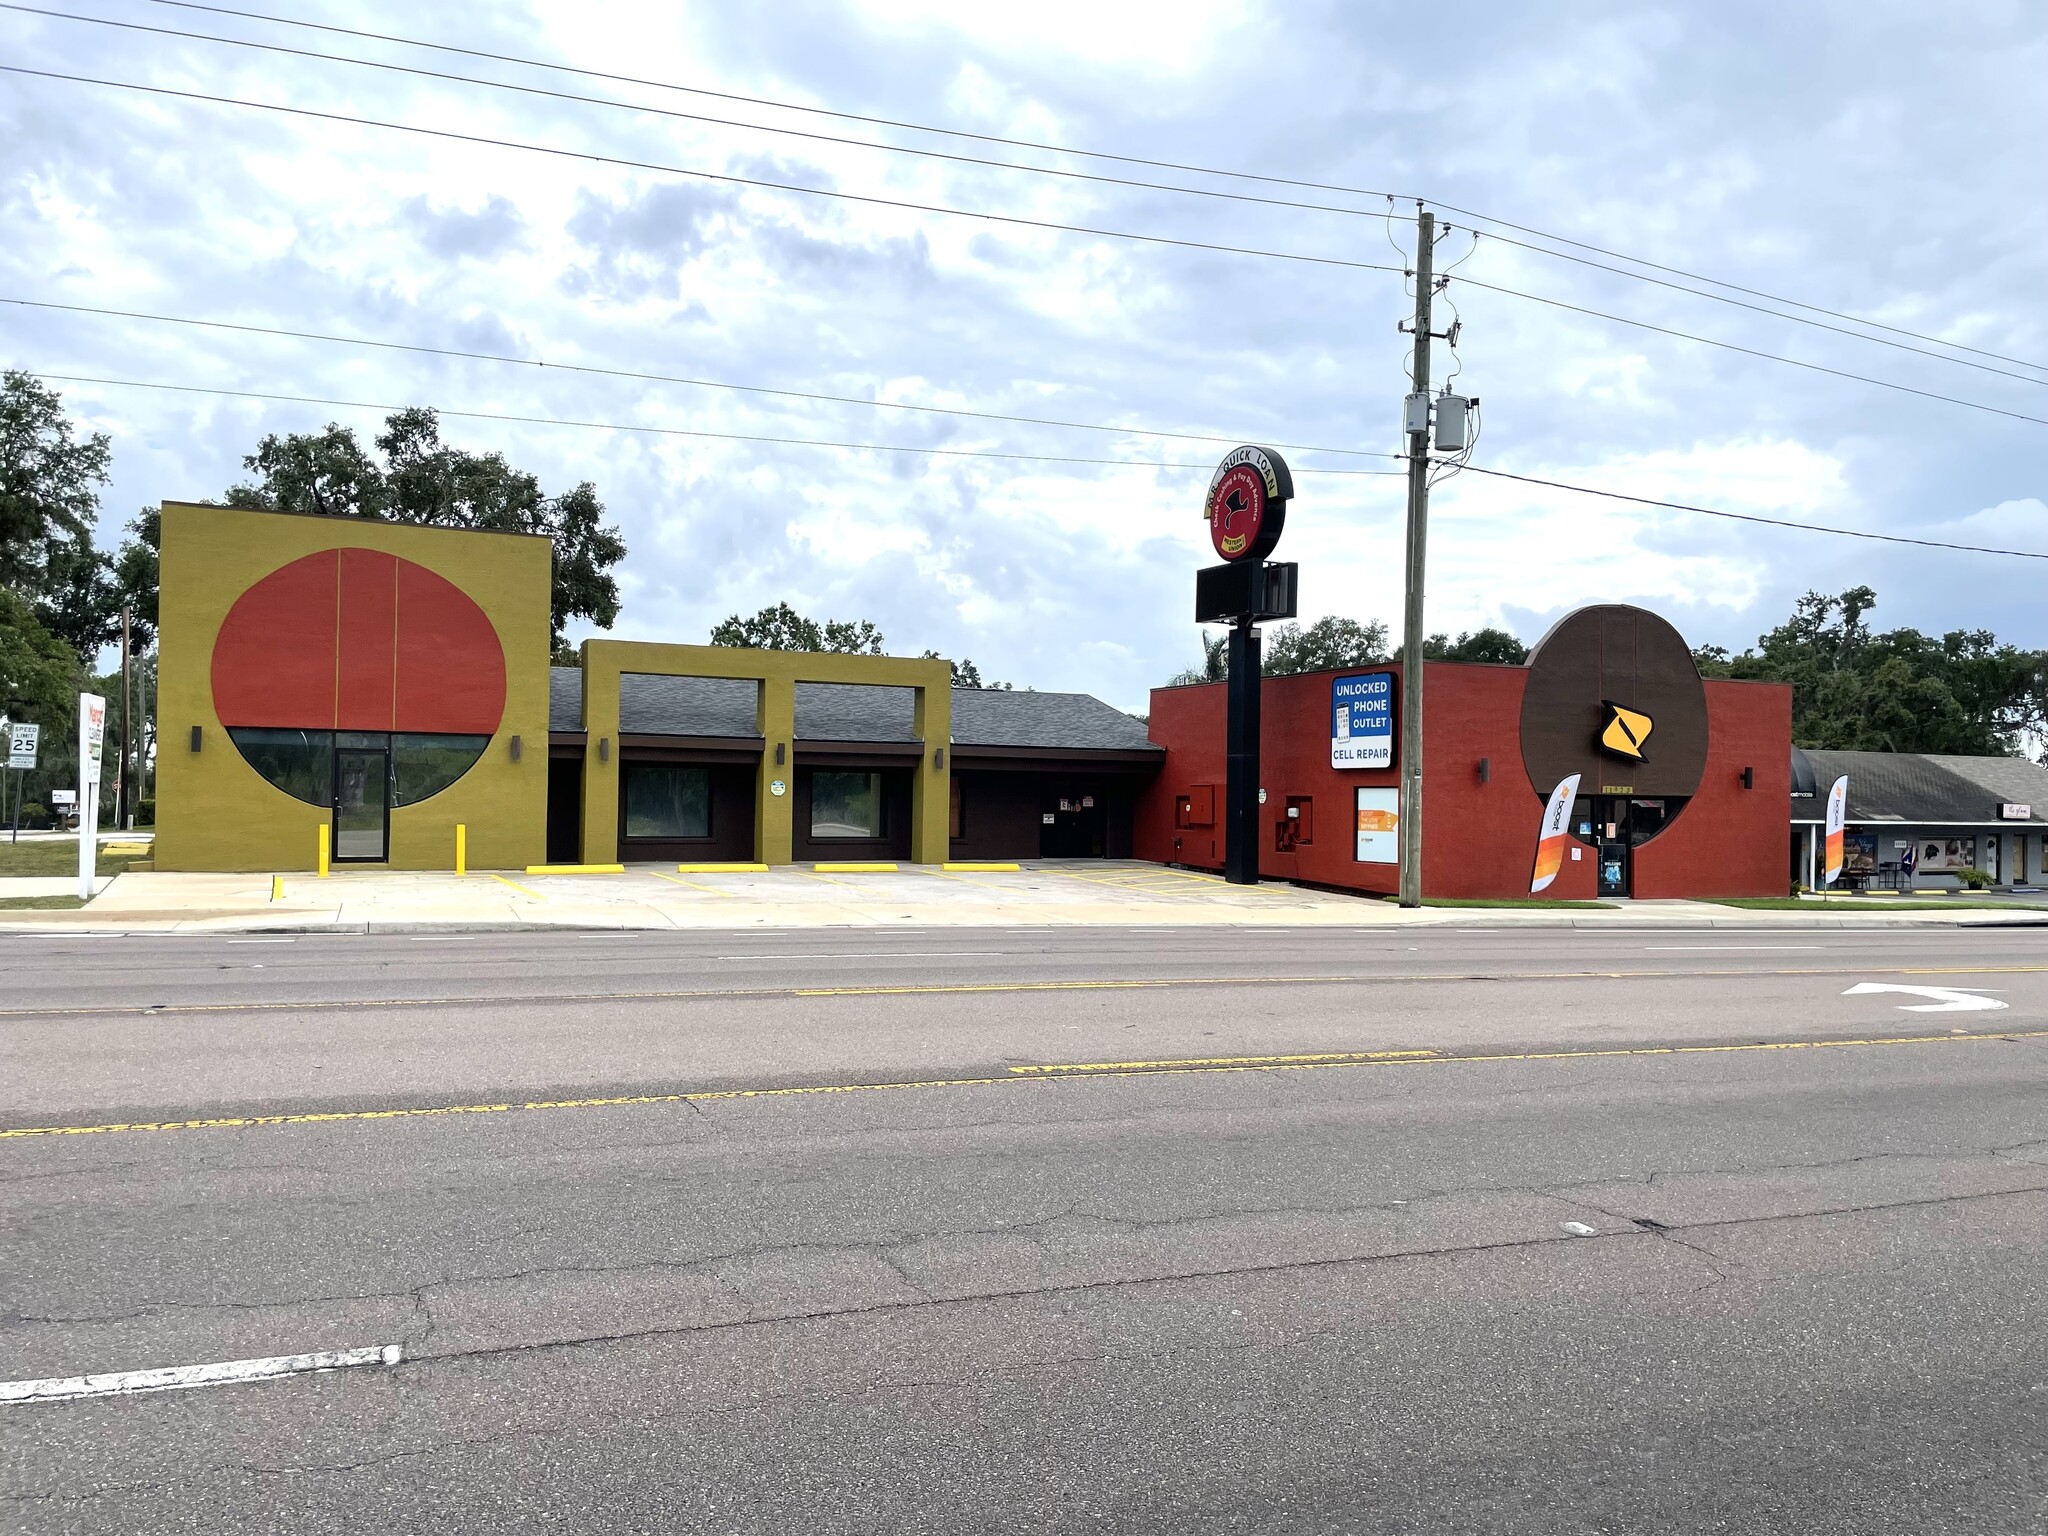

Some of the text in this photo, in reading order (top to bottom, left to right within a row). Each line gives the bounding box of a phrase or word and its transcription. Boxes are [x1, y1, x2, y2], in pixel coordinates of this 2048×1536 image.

[1223, 449, 1251, 473] QUICK
[1256, 453, 1275, 492] LOAN
[1216, 478, 1233, 503] Cashing
[1228, 543, 1243, 551] UNION
[1337, 682, 1387, 696] UNLOCKED
[1353, 699, 1387, 713] PHONE
[1353, 717, 1387, 729] OUTLET
[13, 739, 35, 752] 25
[1333, 748, 1389, 760] CELL REPAIR
[1552, 800, 1565, 831] boost
